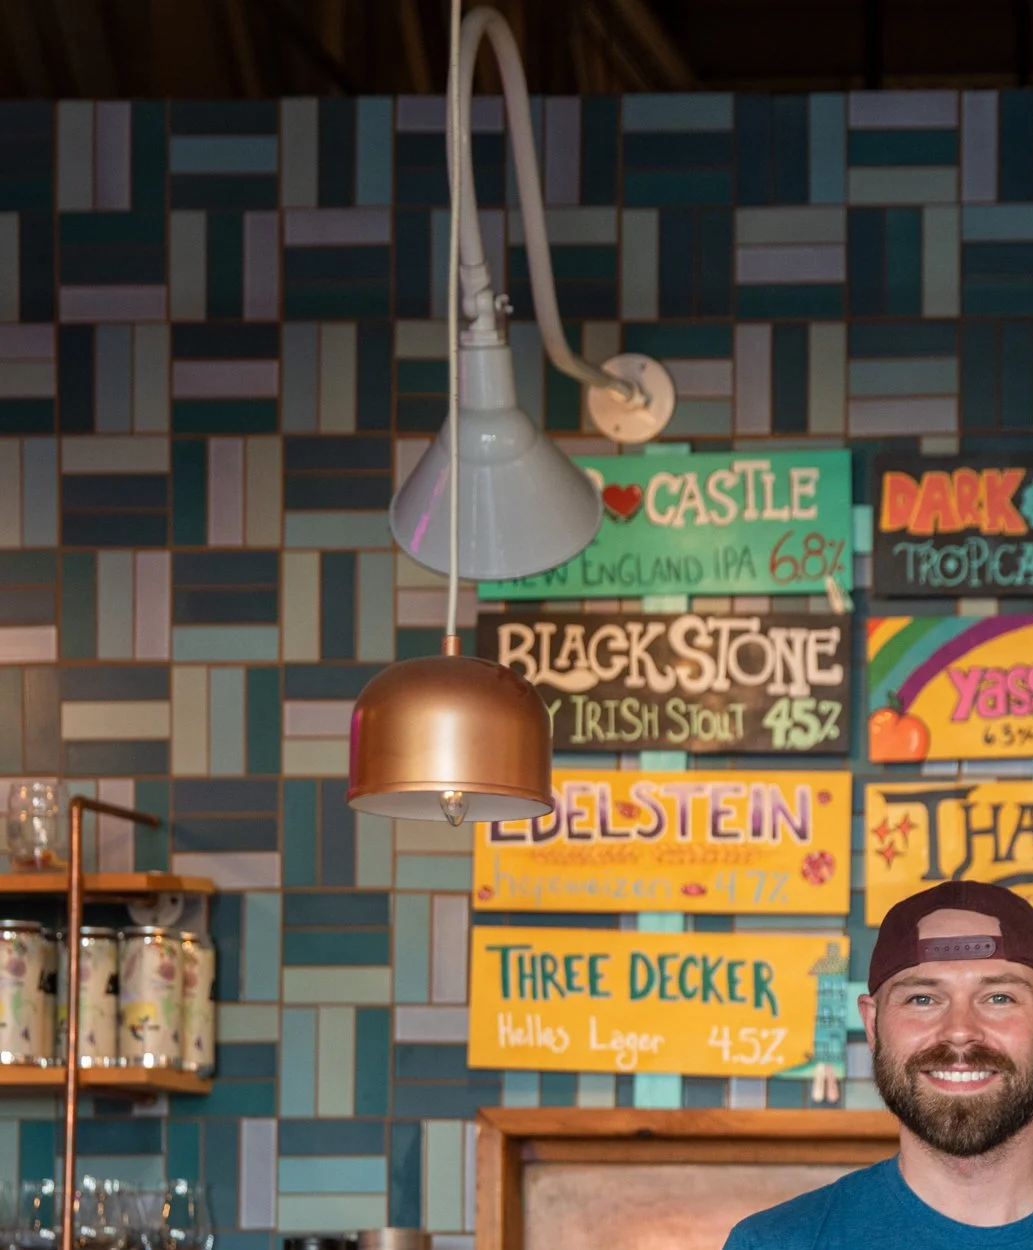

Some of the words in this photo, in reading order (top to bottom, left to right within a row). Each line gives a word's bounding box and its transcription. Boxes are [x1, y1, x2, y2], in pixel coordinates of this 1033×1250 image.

[645, 460, 819, 527] CASTLE
[880, 468, 1029, 536] DARK
[713, 545, 756, 582] IPA
[570, 696, 659, 744] IRISH
[485, 944, 611, 1001] THREE
[630, 952, 778, 1018] DECKER
[497, 1012, 569, 1054] Helles
[589, 1015, 665, 1072] Lager
